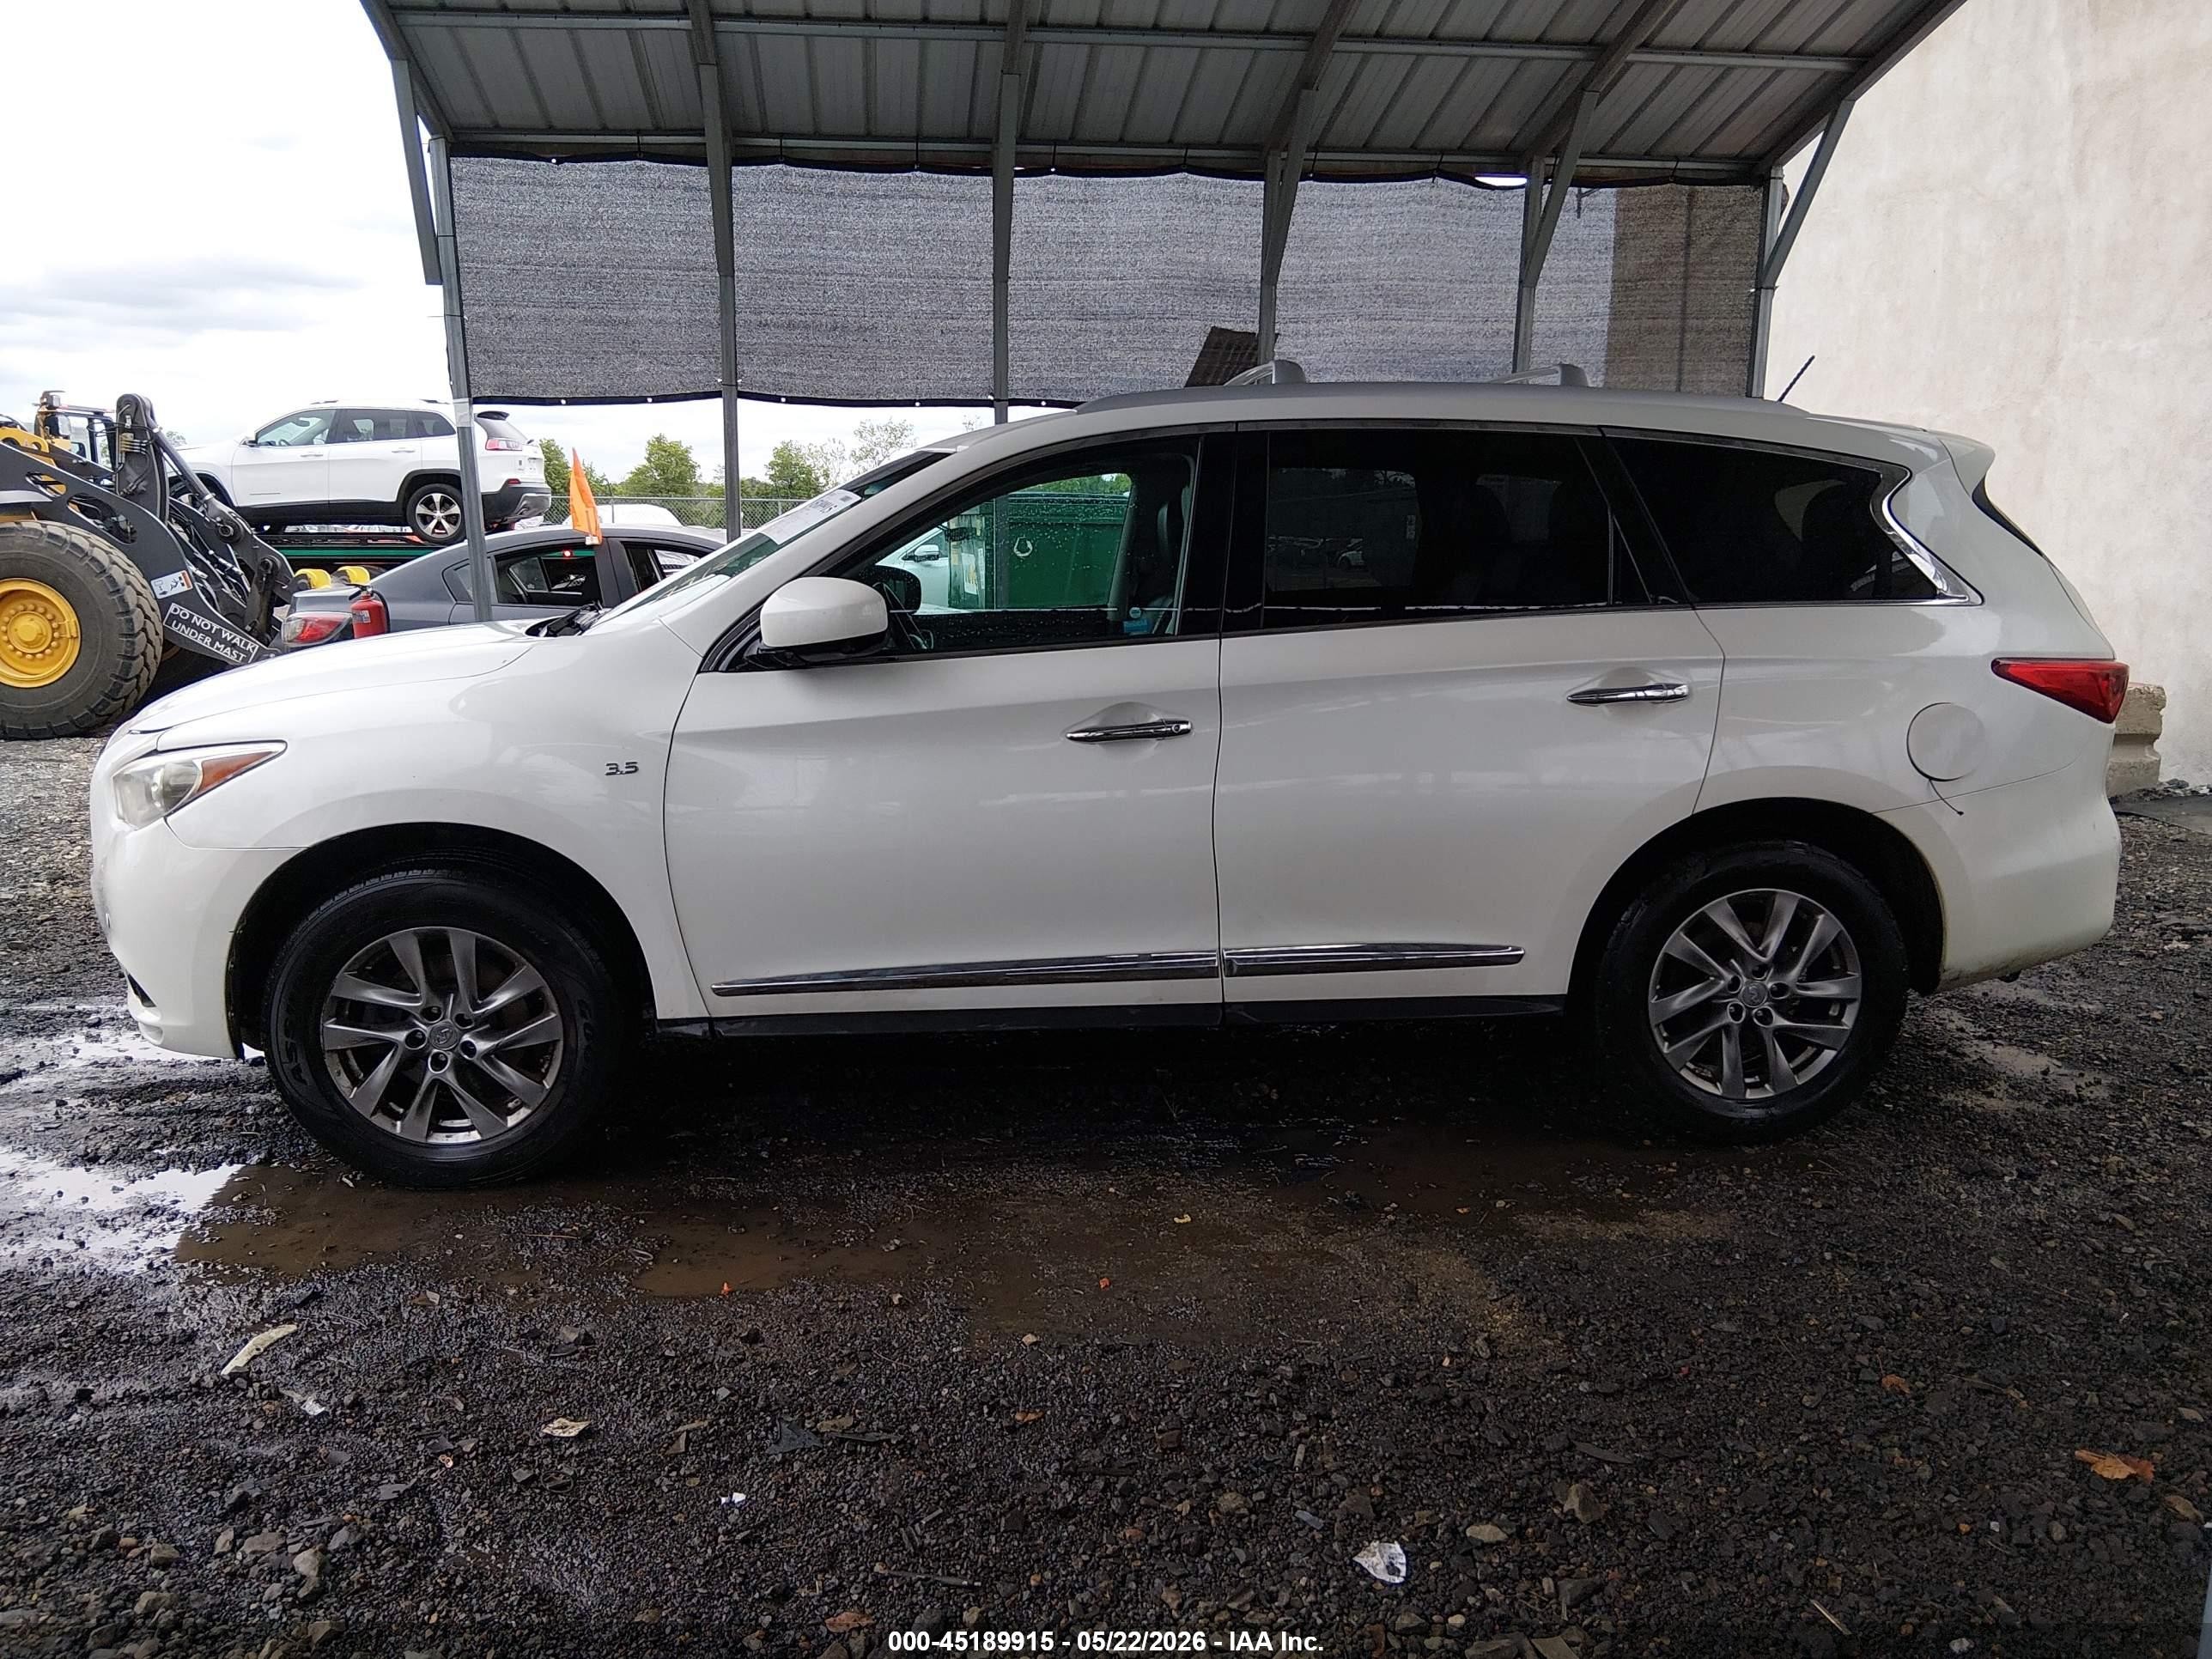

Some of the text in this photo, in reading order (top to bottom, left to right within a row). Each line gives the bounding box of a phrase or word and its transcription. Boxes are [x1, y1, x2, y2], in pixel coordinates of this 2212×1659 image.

[171, 605, 255, 653] DO NOT WALK
[172, 620, 246, 662] UNDER MAST
[605, 761, 639, 775] 3.5
